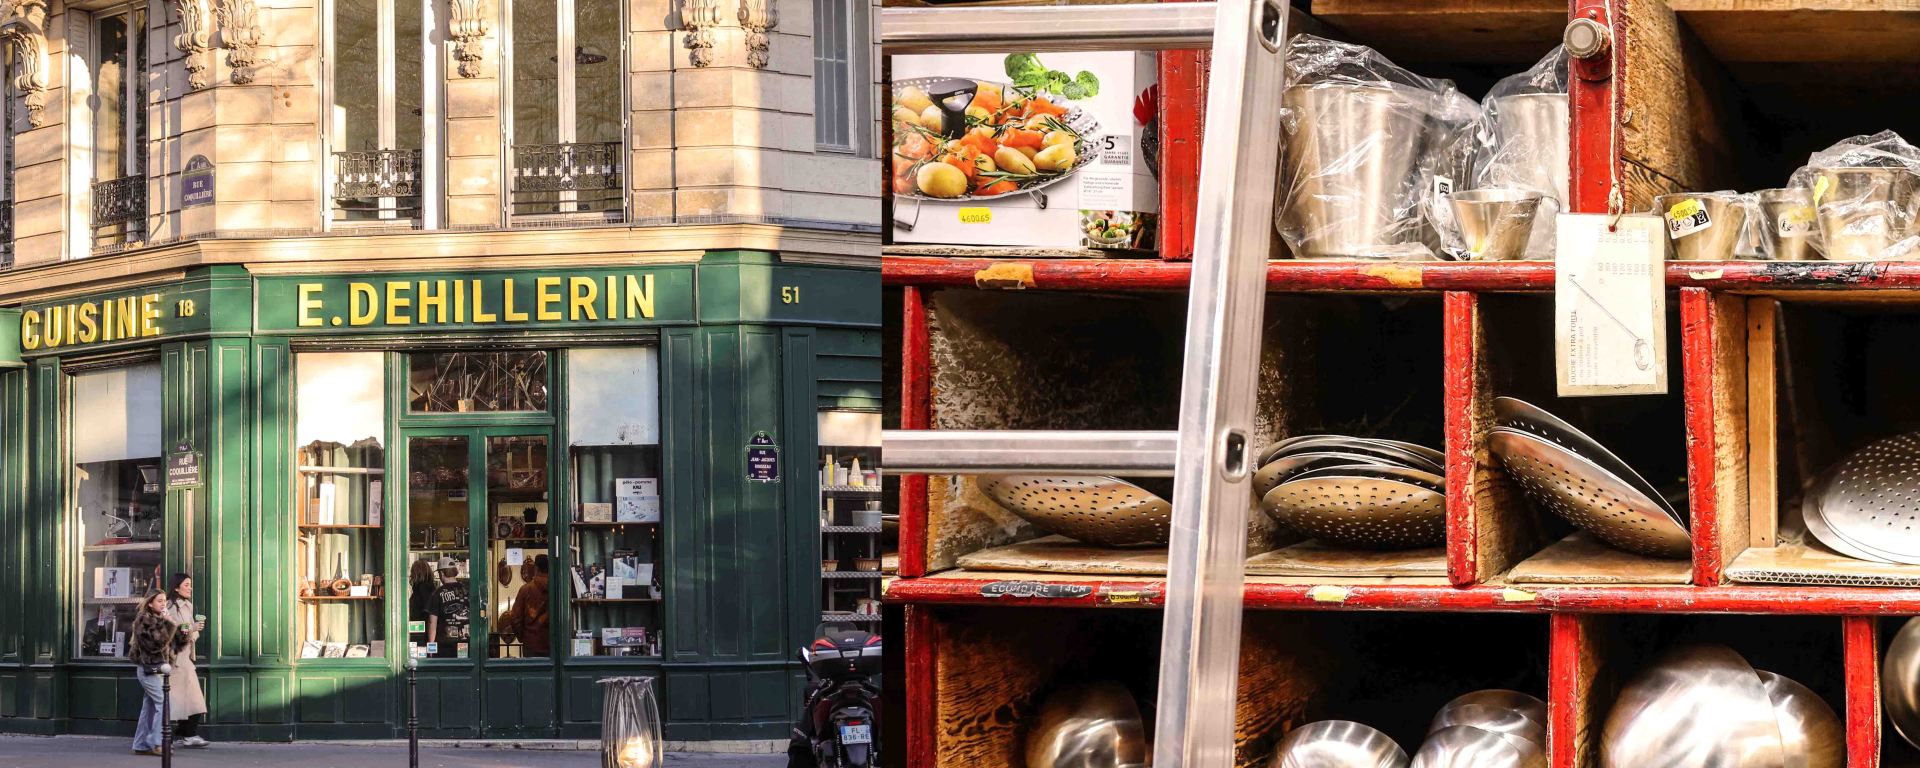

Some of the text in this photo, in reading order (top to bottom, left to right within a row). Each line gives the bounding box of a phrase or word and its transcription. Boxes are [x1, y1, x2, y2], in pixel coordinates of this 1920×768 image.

[177, 299, 194, 317] 18
[297, 274, 655, 326] E.DEHILLERIN
[781, 286, 800, 304] 51
[22, 293, 161, 350] CUISINE
